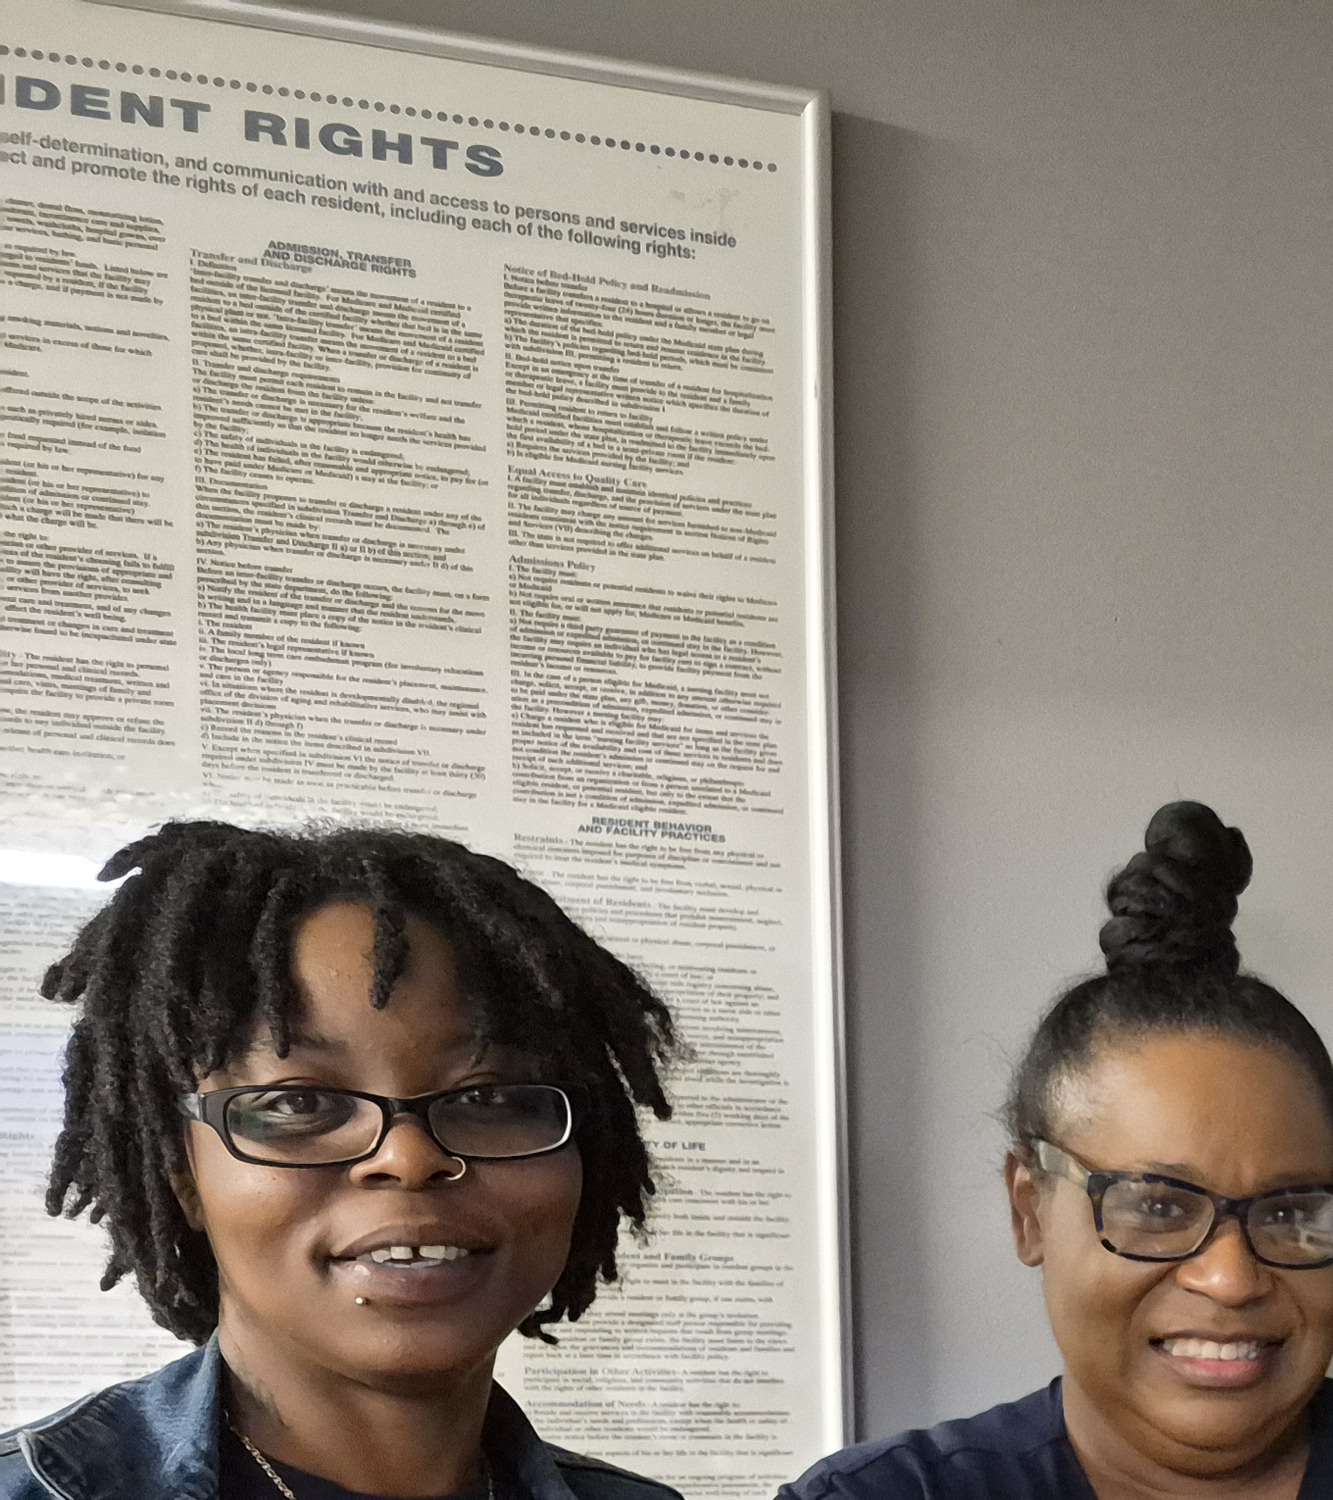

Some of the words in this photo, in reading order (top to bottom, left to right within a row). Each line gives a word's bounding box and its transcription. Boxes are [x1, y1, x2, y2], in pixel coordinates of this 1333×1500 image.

[244, 109, 504, 177] RIGHTS
[32, 153, 66, 172] and
[71, 159, 148, 182] promote
[152, 170, 181, 186] the
[185, 175, 237, 195] rights
[241, 182, 259, 196] of
[263, 187, 306, 204] each
[311, 193, 386, 218] resident,
[390, 203, 468, 230] including
[471, 215, 512, 234] each
[517, 222, 533, 236] of
[538, 225, 564, 241] the
[568, 228, 642, 255] following
[645, 241, 696, 260] rights:
[175, 156, 208, 171] and
[212, 161, 348, 192] communication
[352, 180, 389, 198] with
[393, 186, 425, 203] and
[429, 194, 489, 213] access
[493, 198, 510, 215] to
[514, 204, 581, 225] persons
[585, 214, 616, 230] and
[620, 221, 686, 241] services
[690, 228, 737, 248] inside
[263, 249, 290, 261] AND
[294, 253, 367, 271] DISCHARGE
[371, 264, 417, 279] RIGHTS
[268, 240, 343, 260] ADMISSION,
[347, 250, 412, 268] TRANSFER
[507, 464, 537, 475] Equal
[539, 469, 570, 479] Access
[573, 472, 583, 480] to
[585, 473, 621, 486] Quality
[623, 478, 648, 487] Care
[578, 824, 602, 834] AND
[606, 826, 657, 838] FACILITY
[661, 831, 726, 843] PRACTICES
[592, 816, 651, 829] RESIDENT
[653, 821, 712, 832] BEHAVIOR
[663, 1141, 678, 1149] OF
[682, 1142, 705, 1151] LIFE
